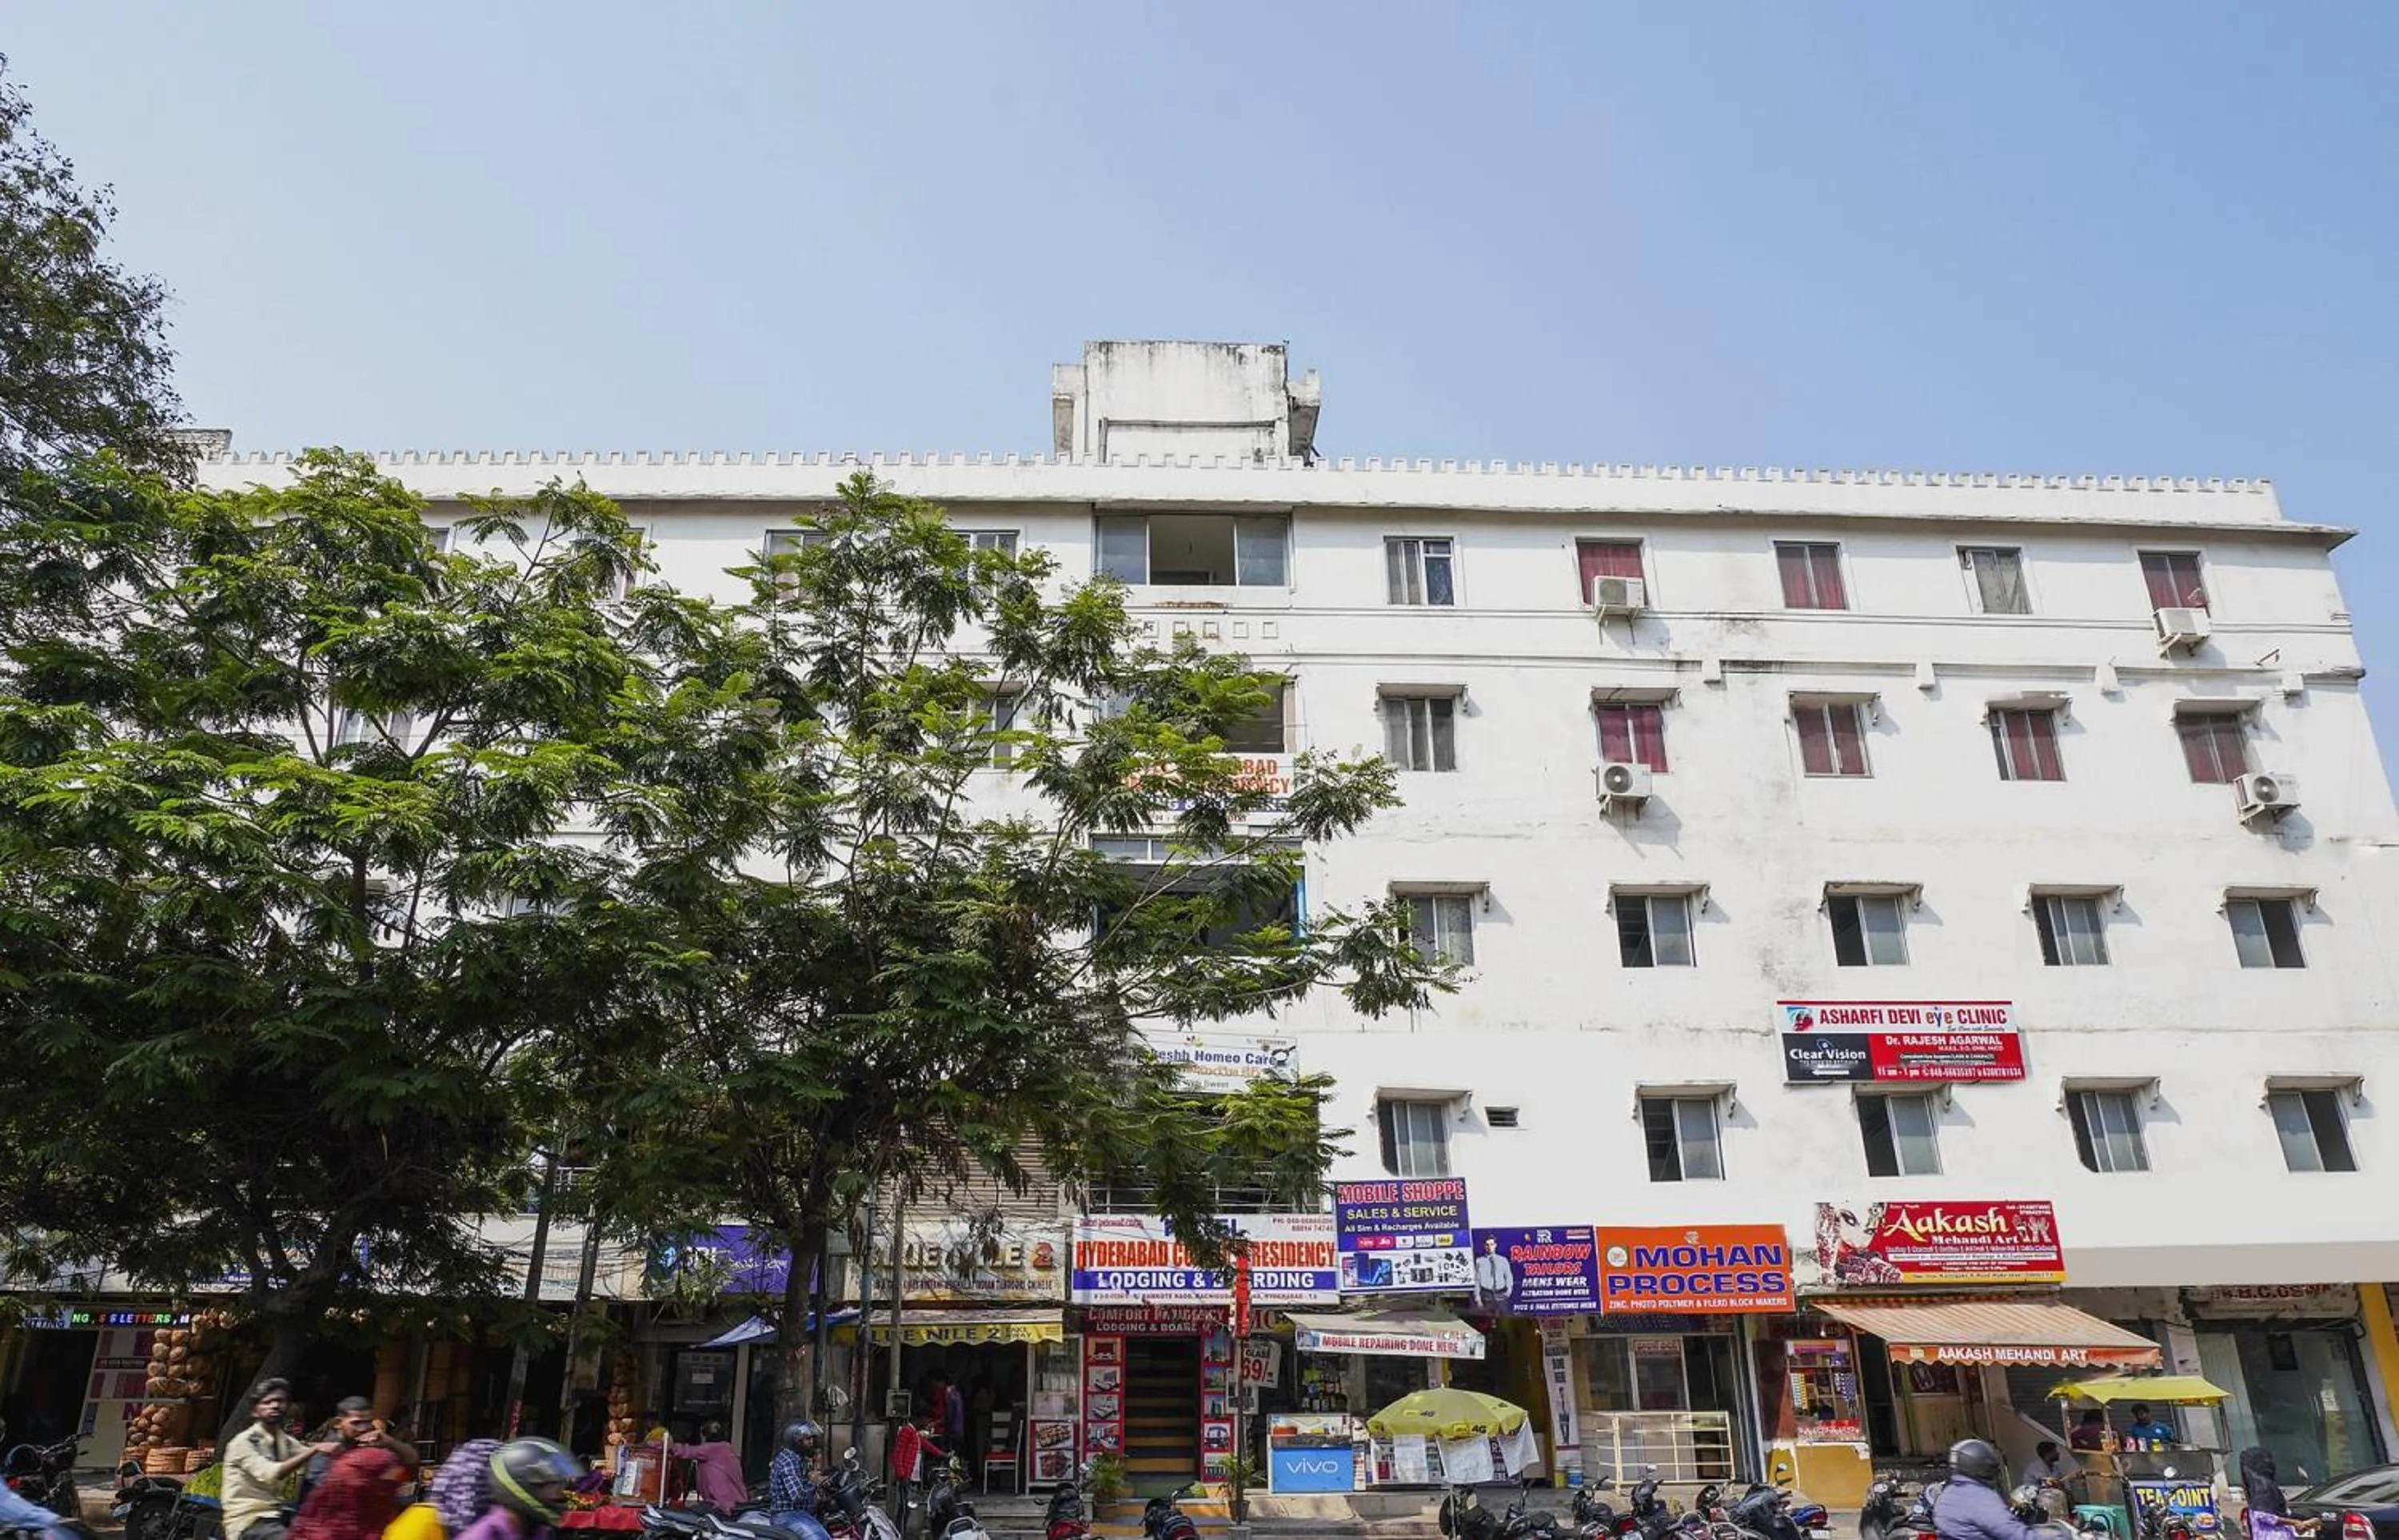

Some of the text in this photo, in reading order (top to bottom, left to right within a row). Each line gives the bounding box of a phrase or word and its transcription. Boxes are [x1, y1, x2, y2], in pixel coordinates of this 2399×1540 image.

[1820, 1009, 1883, 1024] ASHARFI
[1889, 1009, 1921, 1024] DEVI
[1958, 1009, 2007, 1024] CLINIC
[1886, 1035, 2002, 1045] Dr. RAJESH AGARWAL
[1195, 1050, 1240, 1063] Homeo
[1246, 1052, 1277, 1065] Care
[1789, 1048, 1867, 1059] Clear Vision
[1339, 1180, 1464, 1204] MOBILE SHOPPE
[1347, 1205, 1457, 1219] SALES & SERVICE
[1882, 1207, 2010, 1243] Aakash
[1931, 1235, 2019, 1244] Mehandi Art
[1032, 1241, 1054, 1268] 2
[1076, 1241, 1168, 1267] HYDERABAD
[1252, 1241, 1335, 1267] RESIDENCY
[1510, 1244, 1592, 1262] RAINBOW
[1635, 1244, 1782, 1268] MOHAN
[1524, 1262, 1583, 1276] TAILORS
[1098, 1272, 1187, 1289] LODGING
[1192, 1272, 1206, 1288] &
[1522, 1276, 1587, 1287] MENS WEAR
[1607, 1273, 1786, 1295] PROCESS
[1631, 1299, 1656, 1308] PHOTO
[1659, 1299, 1694, 1308] POLYMER
[1730, 1298, 1754, 1307] BLOCK
[1756, 1297, 1787, 1307] MAKERS
[926, 1327, 978, 1341] NILE
[988, 1327, 1000, 1339] 2
[1322, 1337, 1459, 1354] MOBILE REPAIRING DONE HERE
[1938, 1347, 2087, 1361] AAKASH MEHANDI ART
[1471, 1424, 1487, 1433] 4G
[1287, 1458, 1339, 1474] vivo
[2137, 1488, 2209, 1507] TEA POINT
